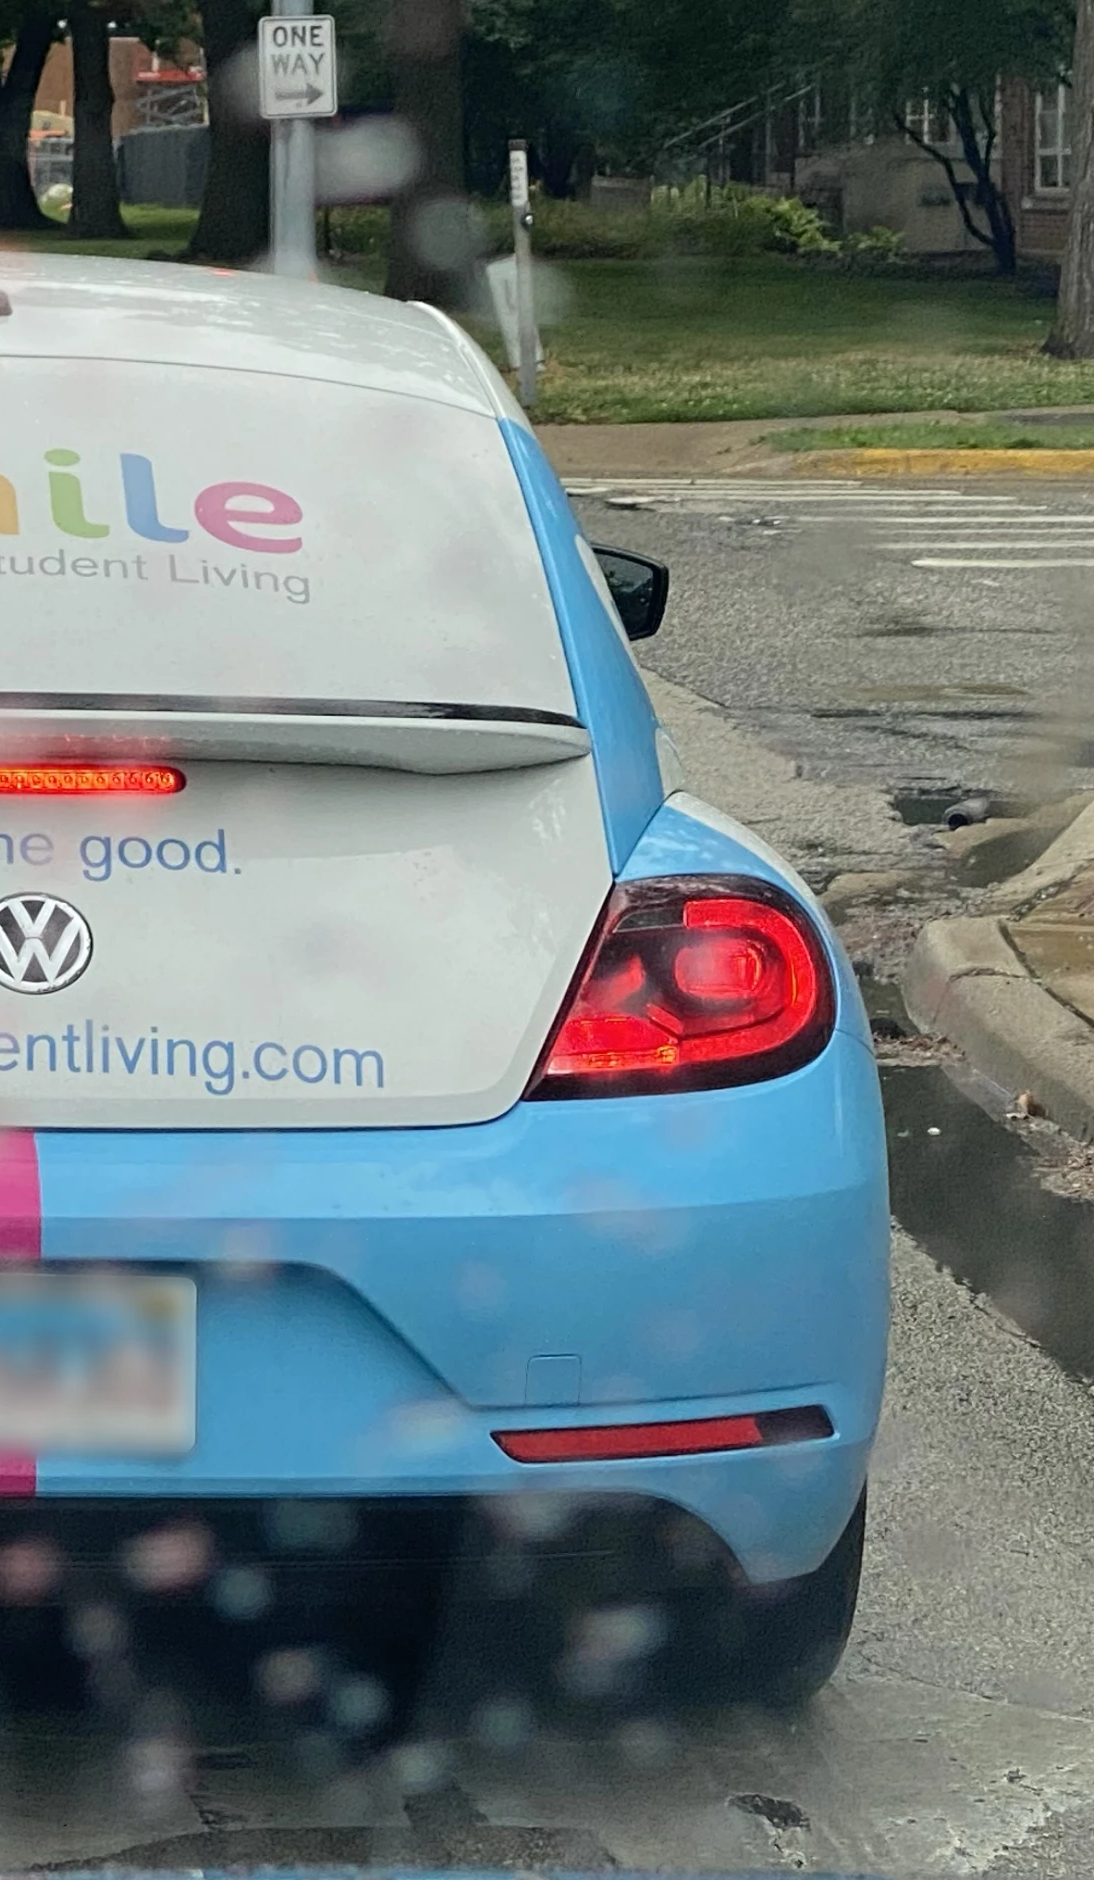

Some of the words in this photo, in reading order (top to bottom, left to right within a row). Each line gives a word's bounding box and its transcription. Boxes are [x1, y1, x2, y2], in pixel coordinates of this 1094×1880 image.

[272, 25, 325, 48] ONE
[270, 52, 325, 76] WAY
[168, 554, 311, 605] Living
[80, 828, 243, 882] good.
